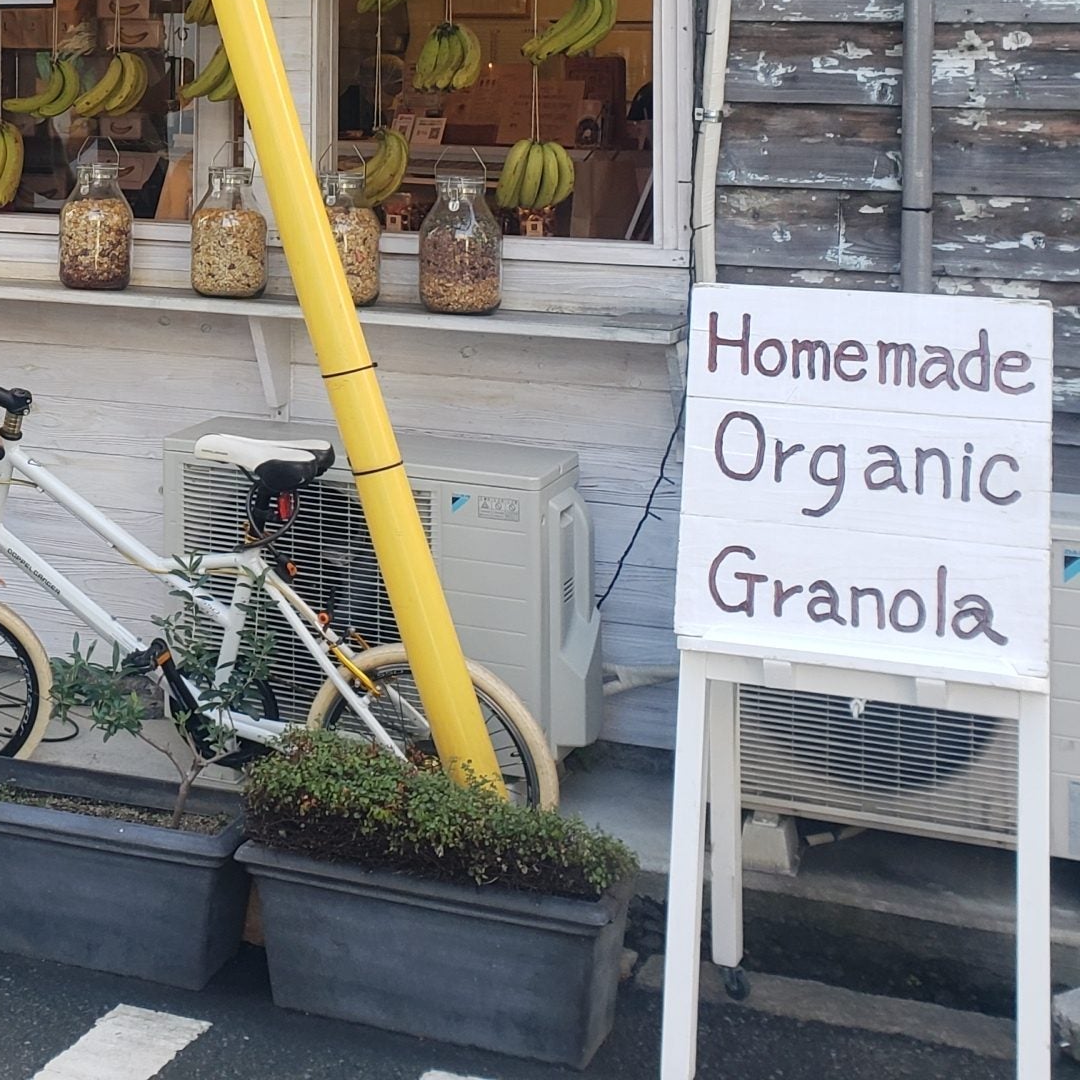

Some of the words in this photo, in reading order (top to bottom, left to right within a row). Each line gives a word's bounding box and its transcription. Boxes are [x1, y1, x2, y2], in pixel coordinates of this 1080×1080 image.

[707, 311, 1036, 395] Homemade
[714, 411, 1022, 518] Organic
[708, 545, 1008, 646] Granola
